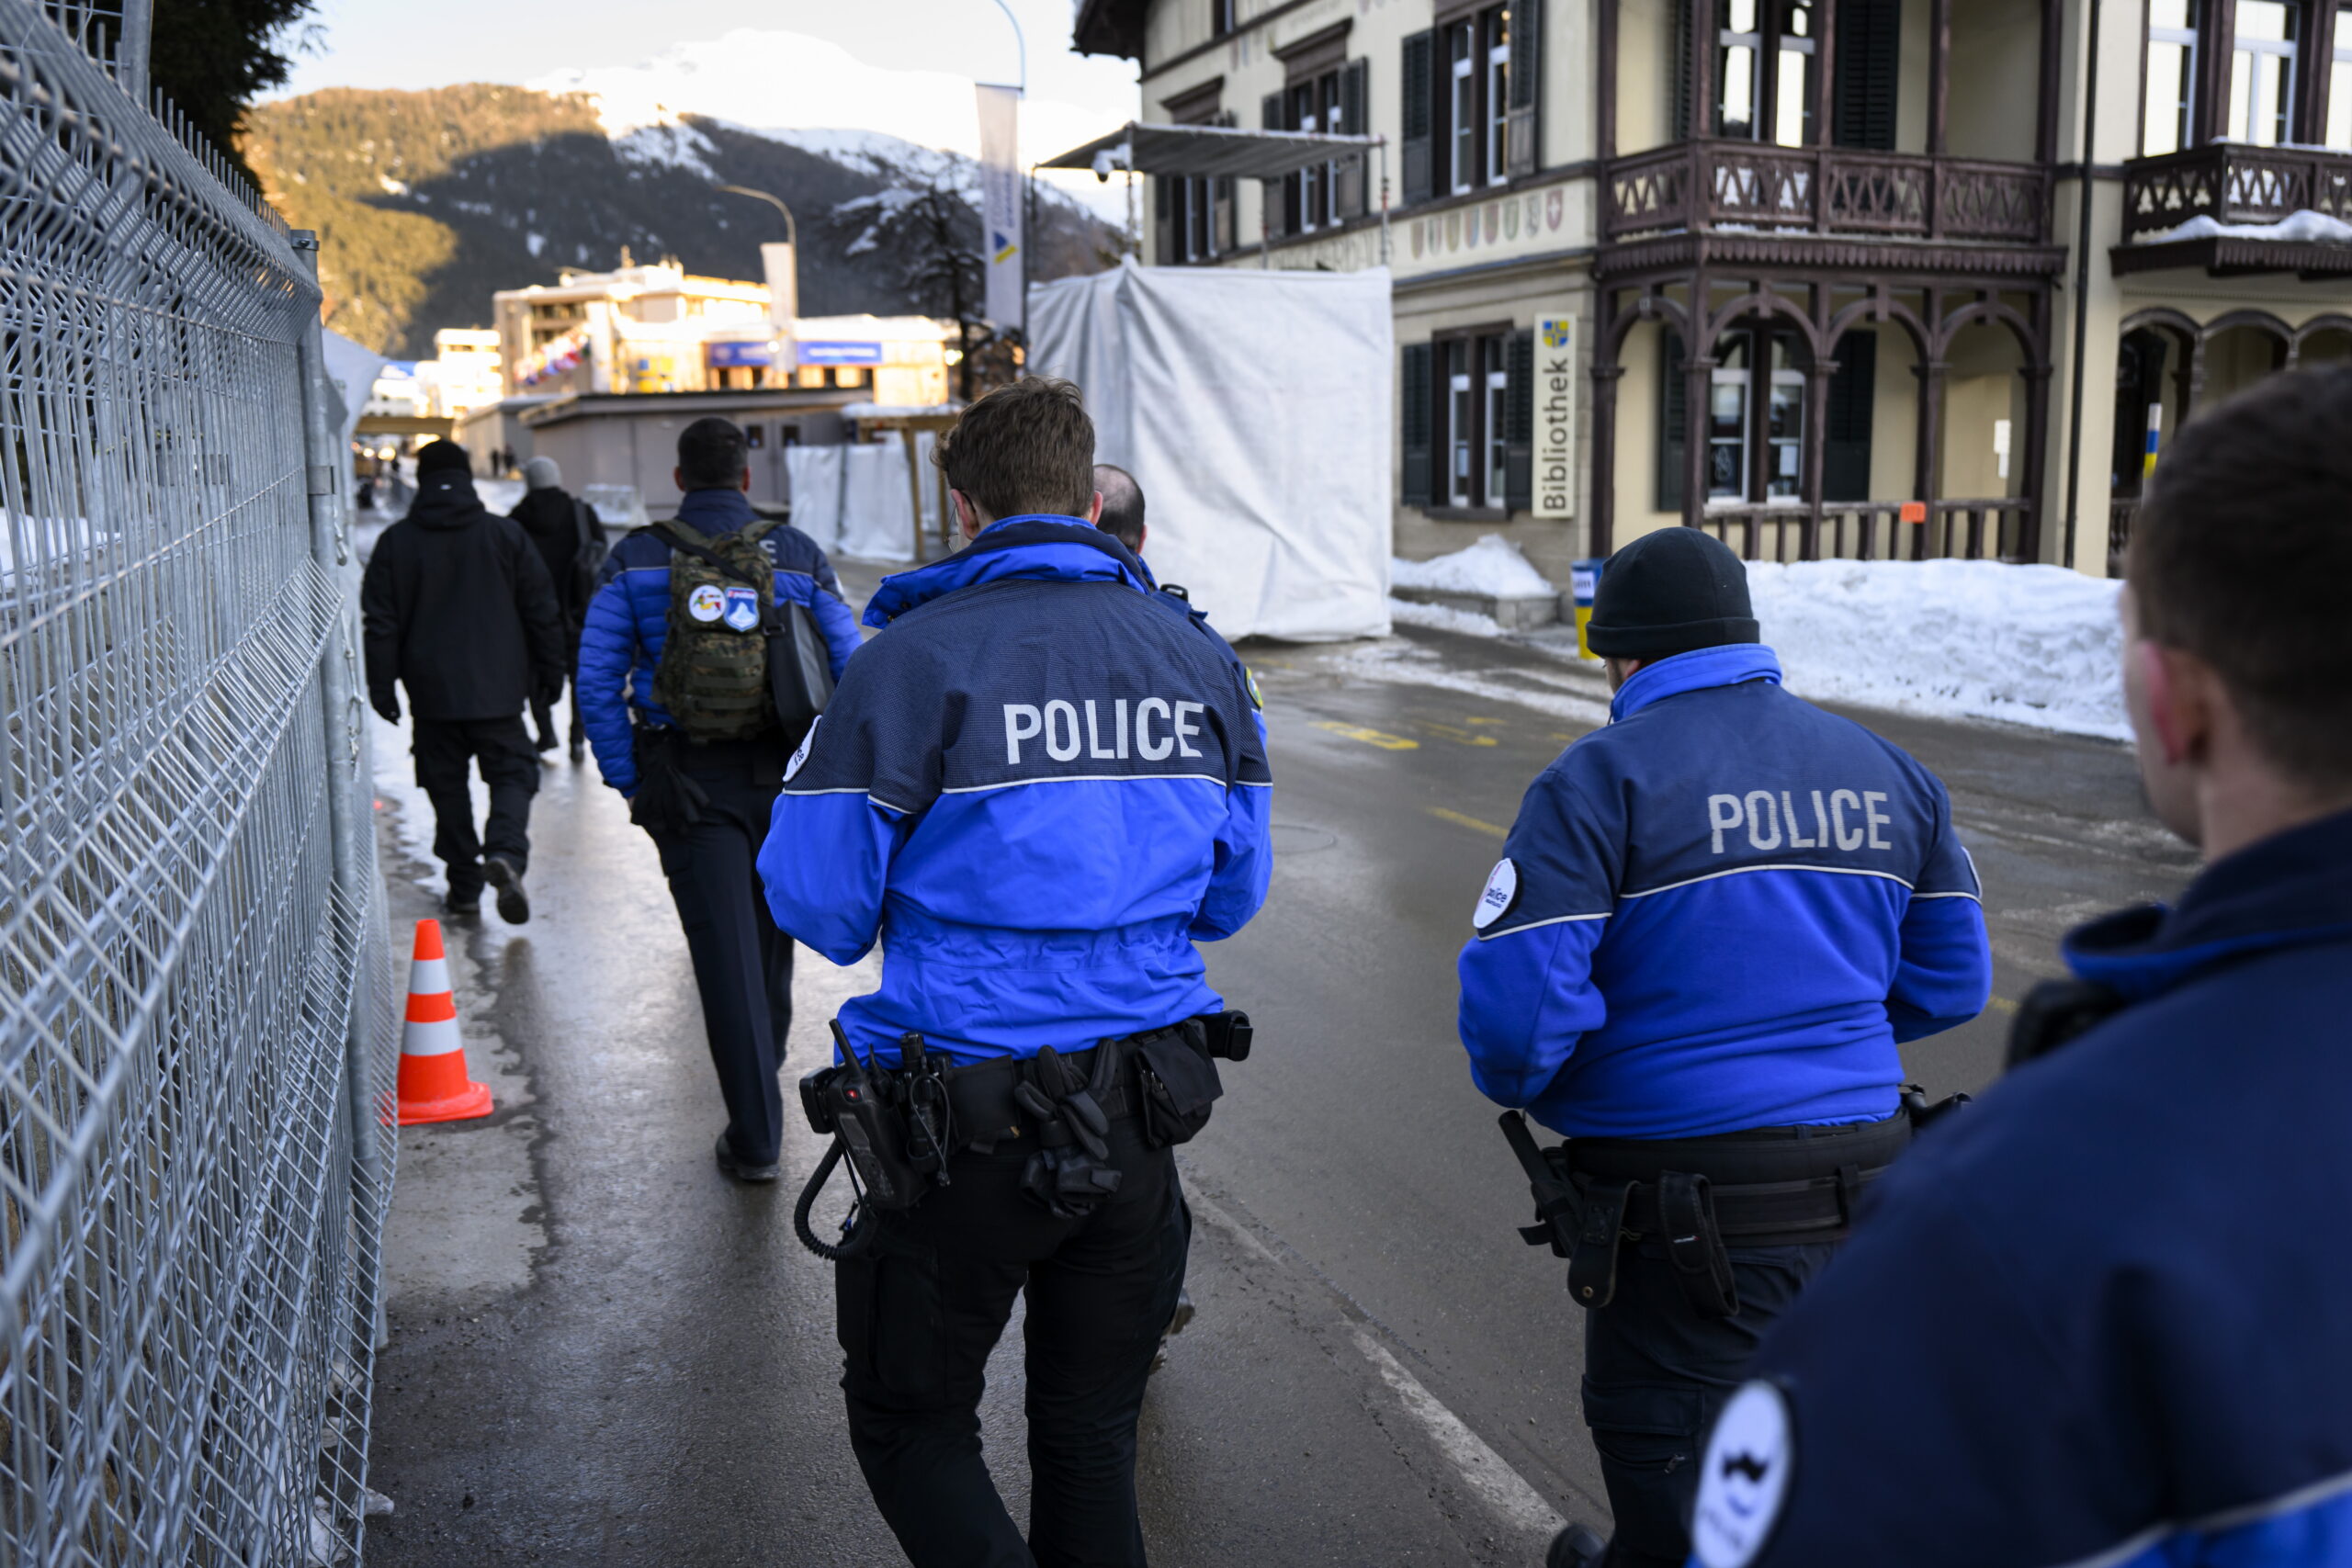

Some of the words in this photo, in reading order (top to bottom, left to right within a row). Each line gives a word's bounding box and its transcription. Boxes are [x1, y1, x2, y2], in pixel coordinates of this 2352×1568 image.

[1541, 357, 1569, 511] Bibliothek
[1002, 696, 1205, 765] POLICE
[1707, 788, 1893, 854] POLICE
